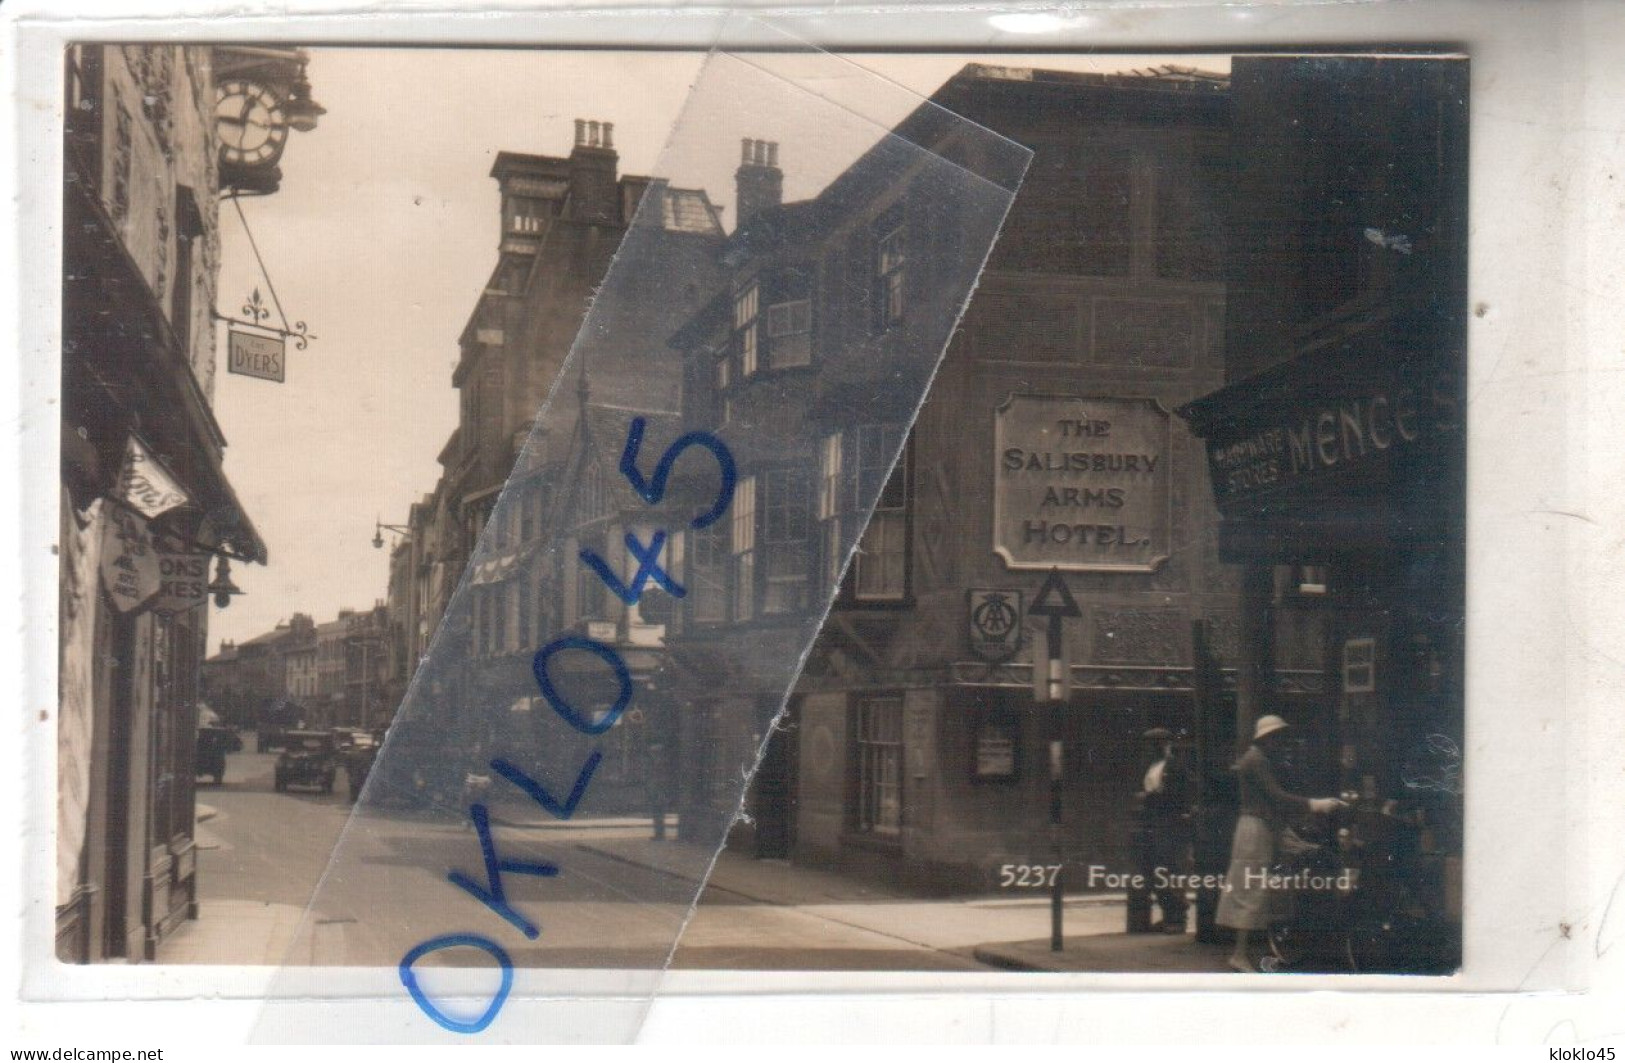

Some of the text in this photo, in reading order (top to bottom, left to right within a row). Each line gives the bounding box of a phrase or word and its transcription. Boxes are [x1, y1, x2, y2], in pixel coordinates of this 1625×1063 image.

[236, 345, 280, 374] DYERS
[1057, 419, 1111, 437] THE
[1005, 448, 1159, 472] SALISBURY
[1042, 486, 1125, 508] ARMS
[1023, 520, 1150, 546] HOTEL.
[159, 558, 204, 578] ONS
